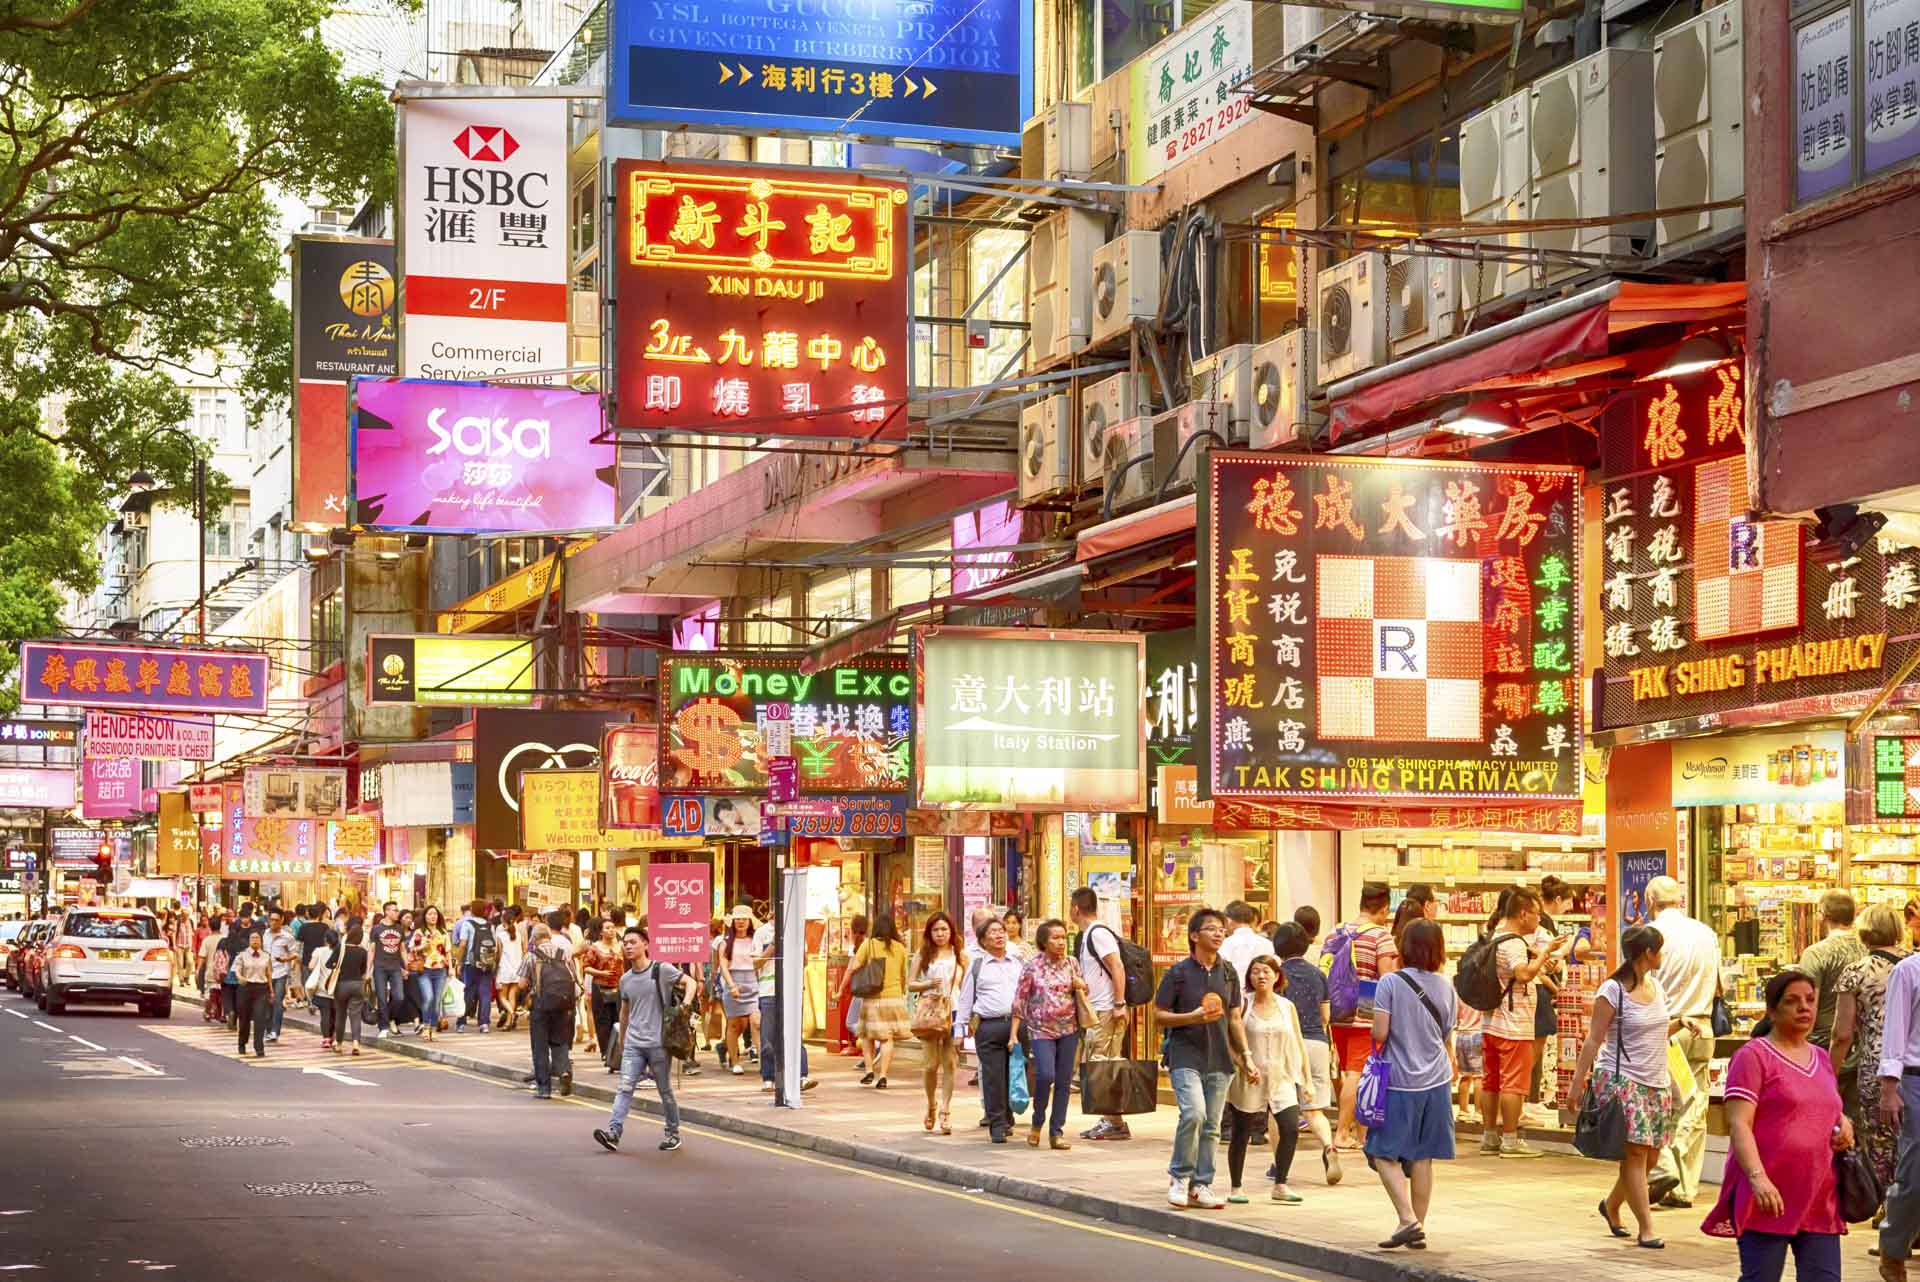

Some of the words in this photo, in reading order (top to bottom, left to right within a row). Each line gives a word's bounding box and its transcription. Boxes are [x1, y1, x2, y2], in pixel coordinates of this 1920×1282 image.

[652, 2, 709, 24] YSL
[721, 14, 809, 33] BOTTEGA
[649, 27, 782, 52] GIVENCHY
[793, 38, 918, 63] BURBERRY
[926, 47, 1002, 70] DIOR
[760, 62, 896, 99] 海利行3樓
[1182, 116, 1214, 153] 2827
[1217, 94, 1251, 131] 2928
[423, 165, 549, 209] HSBC
[669, 194, 856, 255] 新斗記
[468, 288, 507, 311] 2/F
[706, 274, 750, 297] XIN
[754, 277, 804, 299] DAU
[805, 280, 825, 304] JI
[431, 341, 542, 364] Commercial
[717, 327, 887, 374] 九龍中心
[316, 360, 376, 374] RESTAURANT
[1247, 470, 1547, 548] 德成大藥房
[1627, 665, 1670, 701] TAK
[1675, 653, 1745, 695] SHING
[1756, 631, 1889, 684] PHARMACY
[679, 667, 812, 702] Money
[835, 669, 910, 696] Exc
[950, 674, 1116, 718] 意大利站
[31, 729, 74, 741] BONJOUR
[91, 716, 174, 740] HENDERSON
[90, 742, 133, 755] ROSEWOOD
[135, 743, 176, 757] FURNITURE
[184, 744, 209, 757] CHEST
[993, 734, 1030, 751] Italy
[1036, 735, 1098, 751] Station
[1346, 757, 1369, 769] O/B
[1370, 758, 1395, 770] TAK
[1509, 760, 1560, 773] LIMITED
[1234, 765, 1289, 789] TAK
[1300, 766, 1390, 791] SHING
[1399, 769, 1559, 793] PHARMACY
[839, 796, 891, 811] Service
[665, 799, 704, 832] 4D
[791, 815, 845, 835] 3599
[850, 814, 902, 834] 8899
[96, 831, 132, 839] TALORS
[545, 831, 599, 845] Welcome
[1626, 857, 1664, 872] ANNECY
